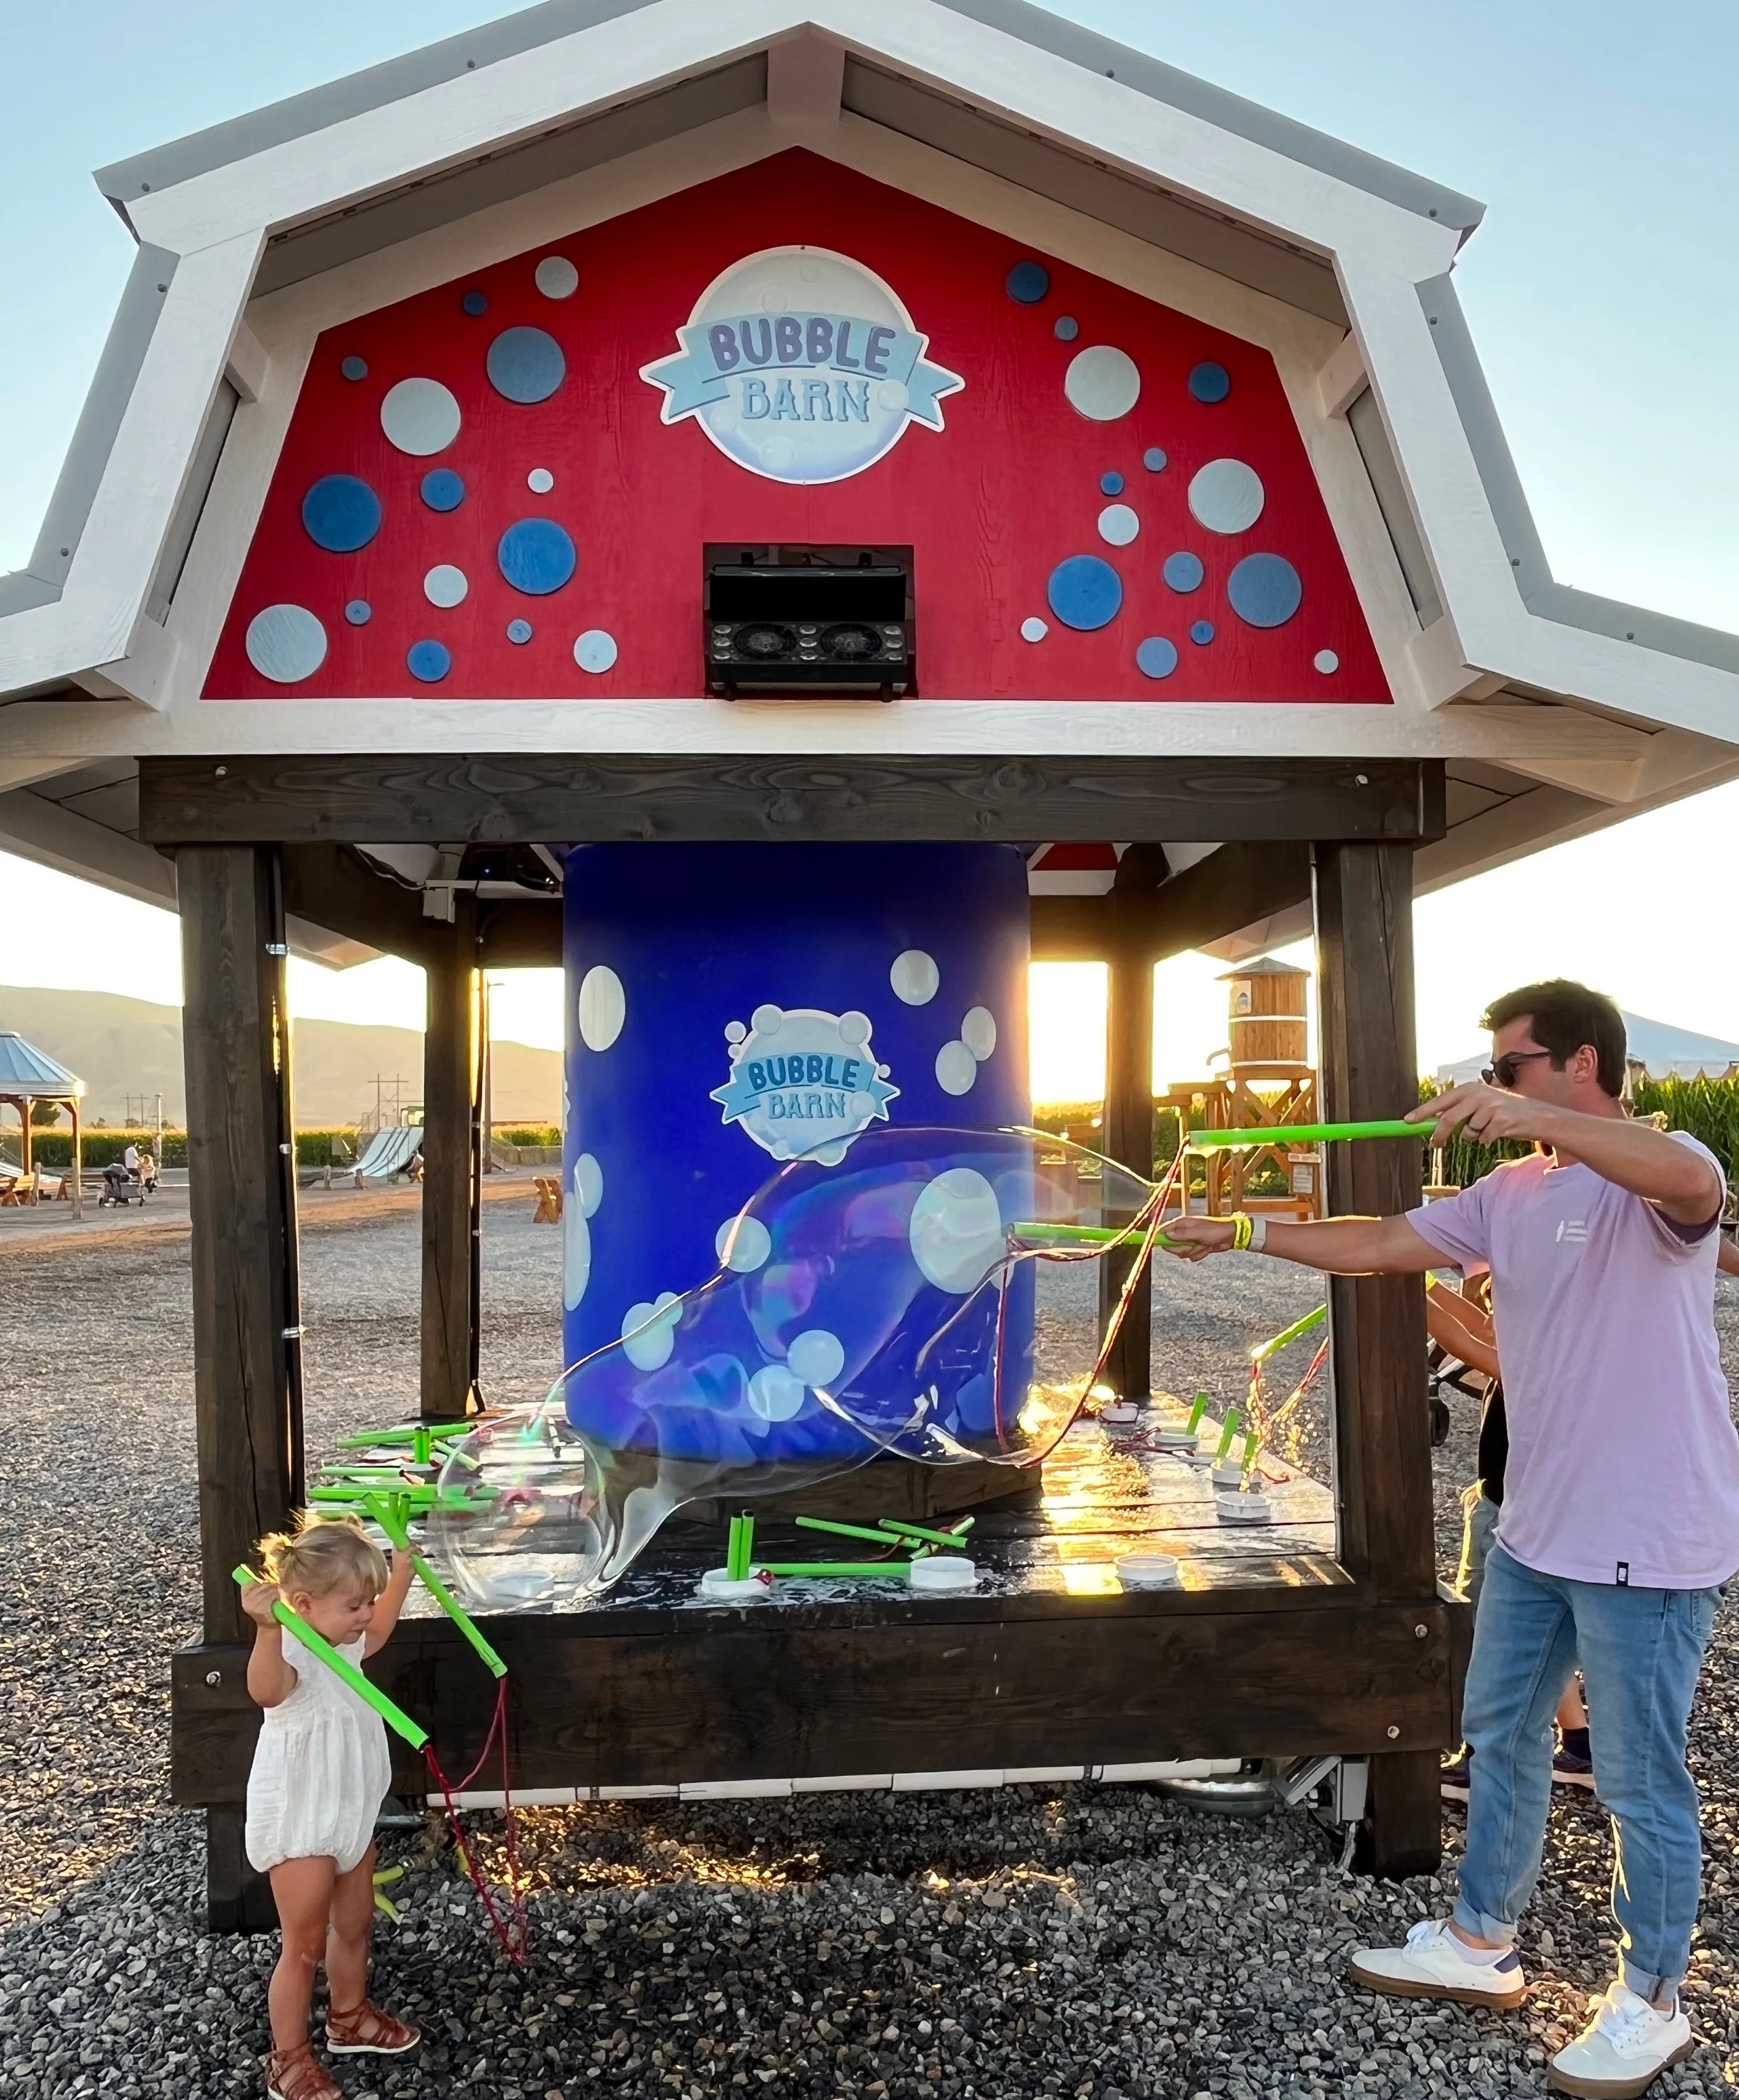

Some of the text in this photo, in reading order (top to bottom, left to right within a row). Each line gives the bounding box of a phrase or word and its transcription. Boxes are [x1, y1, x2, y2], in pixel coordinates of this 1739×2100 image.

[709, 316, 896, 374] BUBBLE
[741, 377, 870, 422] BARN
[748, 1055, 860, 1090] BUBBLE
[768, 1093, 845, 1119] BARN
